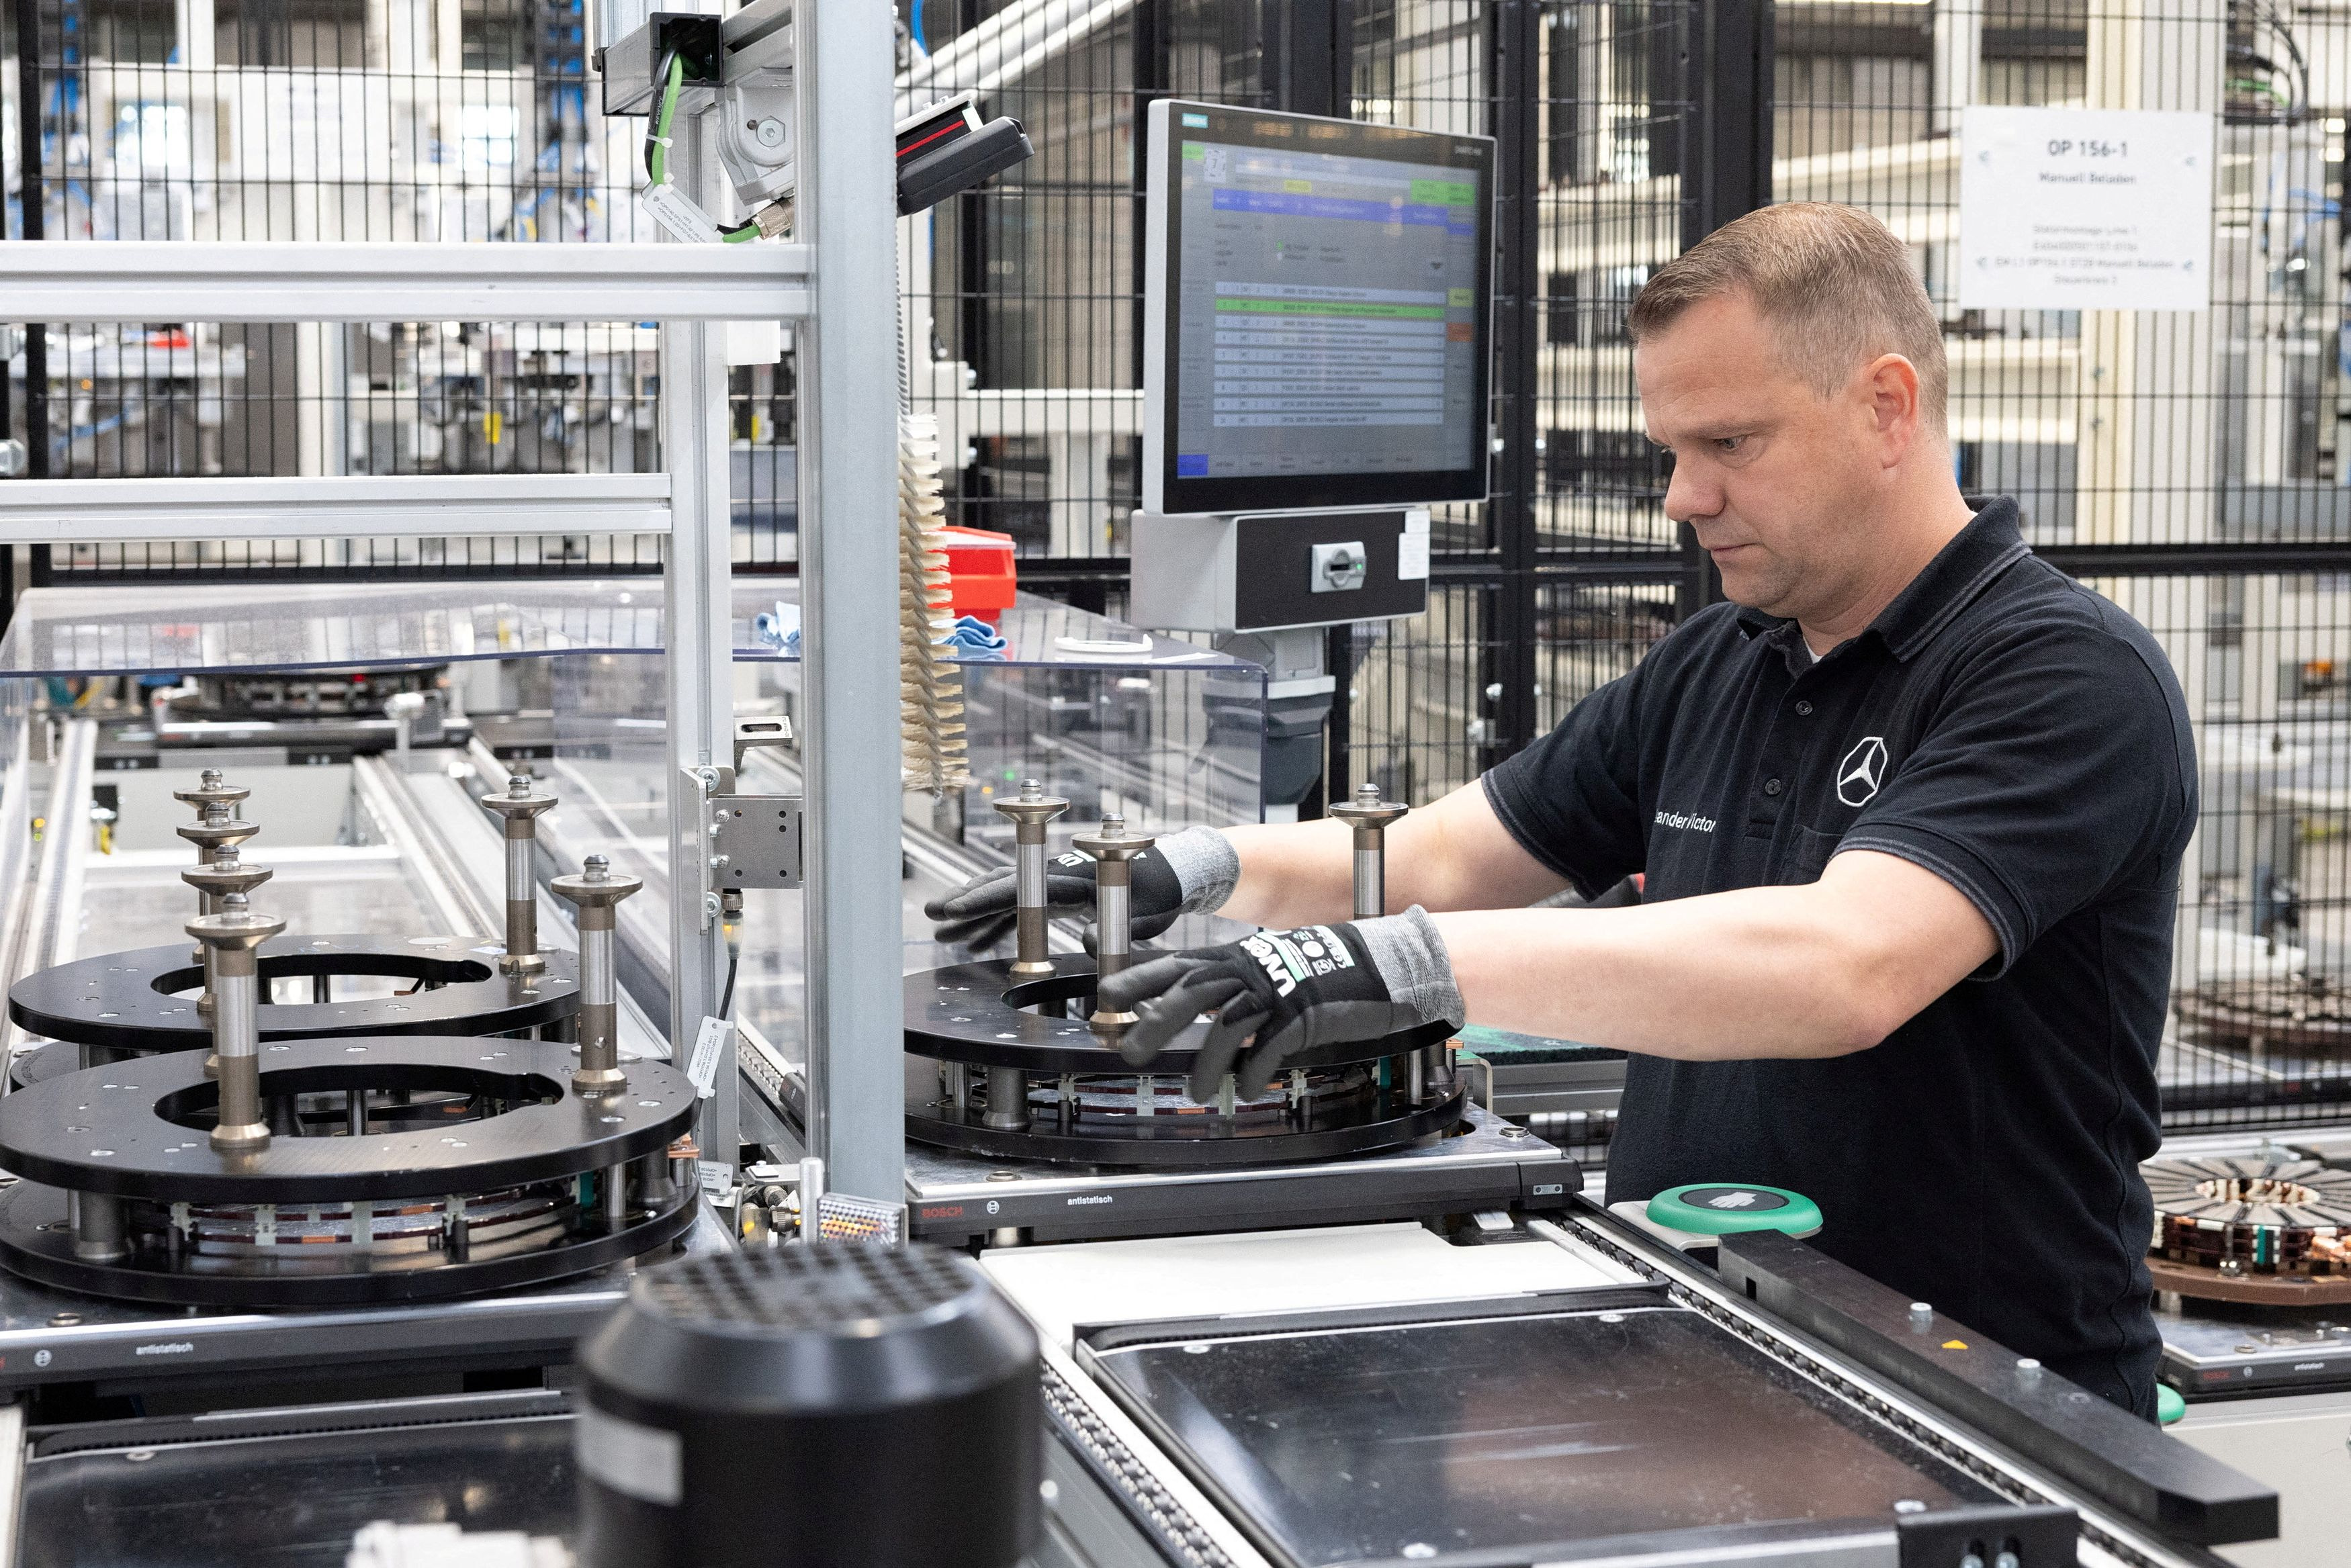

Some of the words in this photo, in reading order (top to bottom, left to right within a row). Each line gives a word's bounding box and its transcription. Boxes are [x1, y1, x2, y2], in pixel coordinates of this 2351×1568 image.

[2047, 139, 2072, 156] OP
[2079, 140, 2129, 158] 156-1
[2039, 171, 2084, 184] Manuell
[1239, 935, 1296, 998] uvex
[921, 1206, 963, 1219] BOSCH
[1067, 1195, 1113, 1206] antistatisch
[136, 1342, 194, 1356] antistatisch
